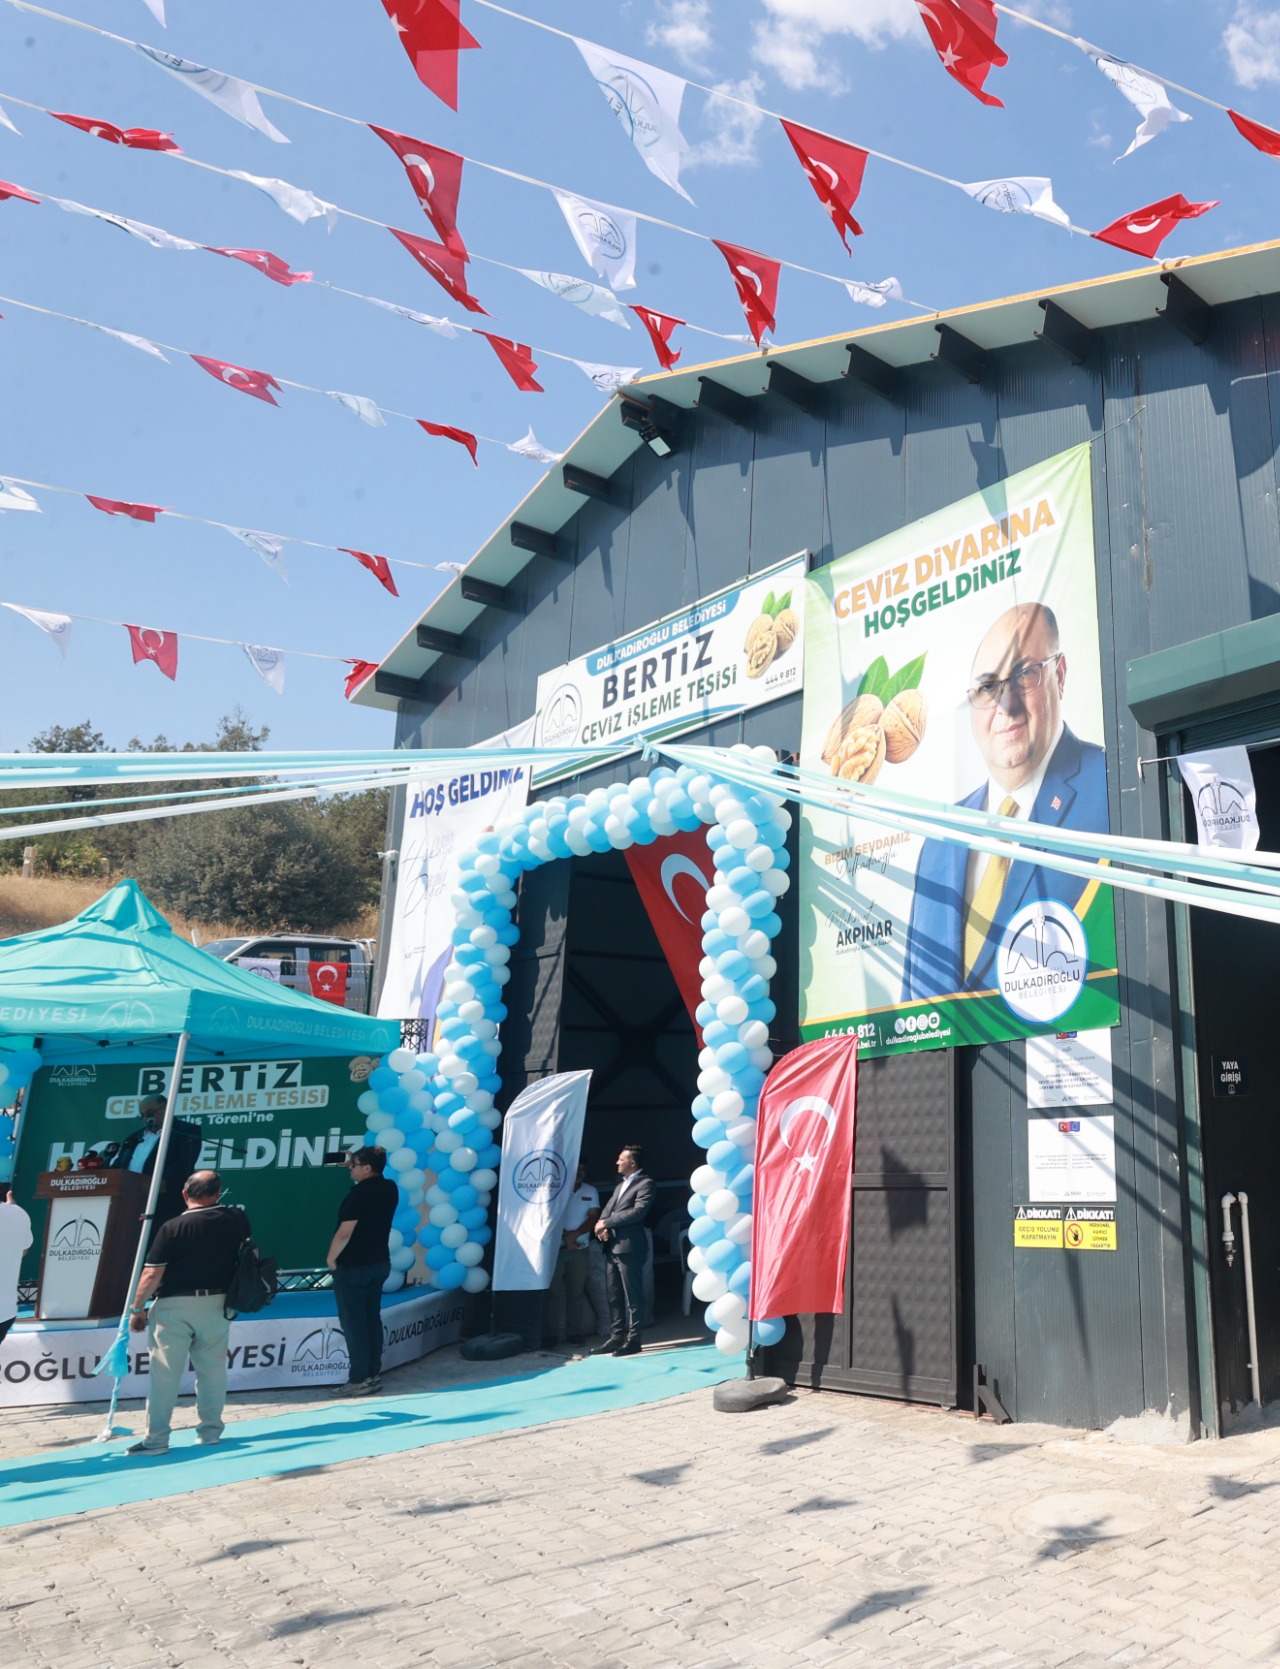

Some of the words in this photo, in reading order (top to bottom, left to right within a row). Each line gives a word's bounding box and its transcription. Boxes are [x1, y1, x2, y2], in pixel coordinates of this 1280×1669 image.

[834, 563, 910, 619] CEVİZ
[914, 499, 1056, 585] DİYARINA
[864, 547, 1022, 638] HOŞGELDİNİZ
[596, 628, 670, 670] DULKADİROĞLU
[672, 599, 727, 637] BELEDİYESİ
[602, 629, 715, 709] BERTİZ
[786, 667, 796, 678] 812
[581, 712, 623, 745] CEVİZ
[627, 687, 682, 727] İŞLEME
[687, 664, 738, 703] TESİSİ
[410, 783, 445, 818] HOŞ
[836, 919, 893, 948] AKPINAR
[1004, 968, 1081, 993] DULKADİROĞLU
[858, 1022, 875, 1038] 812
[141, 1062, 301, 1096] BERTİZ
[1220, 1071, 1241, 1084] GİRİŞİ
[1221, 1061, 1239, 1070] YAYA
[265, 1088, 327, 1107] TESİSİ
[1026, 1207, 1061, 1219] DİKKAT!
[1077, 1208, 1114, 1220] DİKKAT!
